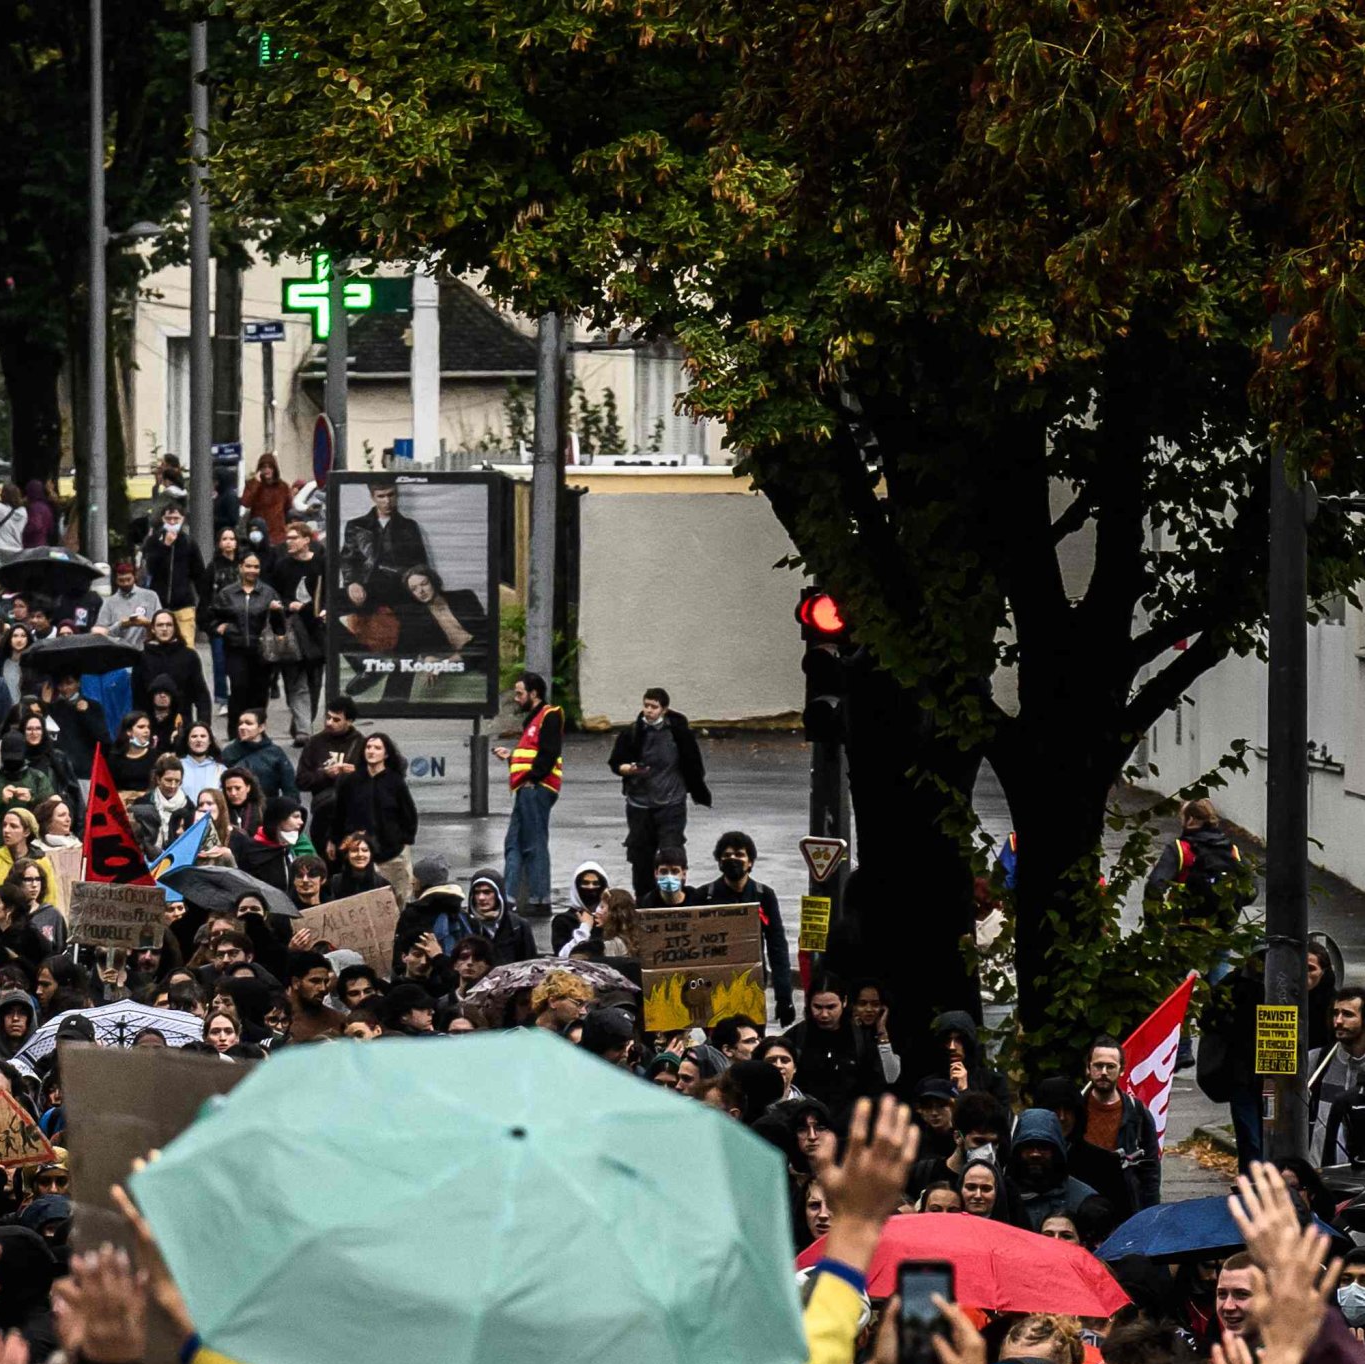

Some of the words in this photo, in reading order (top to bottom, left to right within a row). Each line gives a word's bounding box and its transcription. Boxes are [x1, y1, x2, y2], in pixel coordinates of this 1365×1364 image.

[362, 658, 396, 673] The
[399, 658, 465, 673] Kooples
[1258, 1010, 1296, 1022] EPAVISTE
